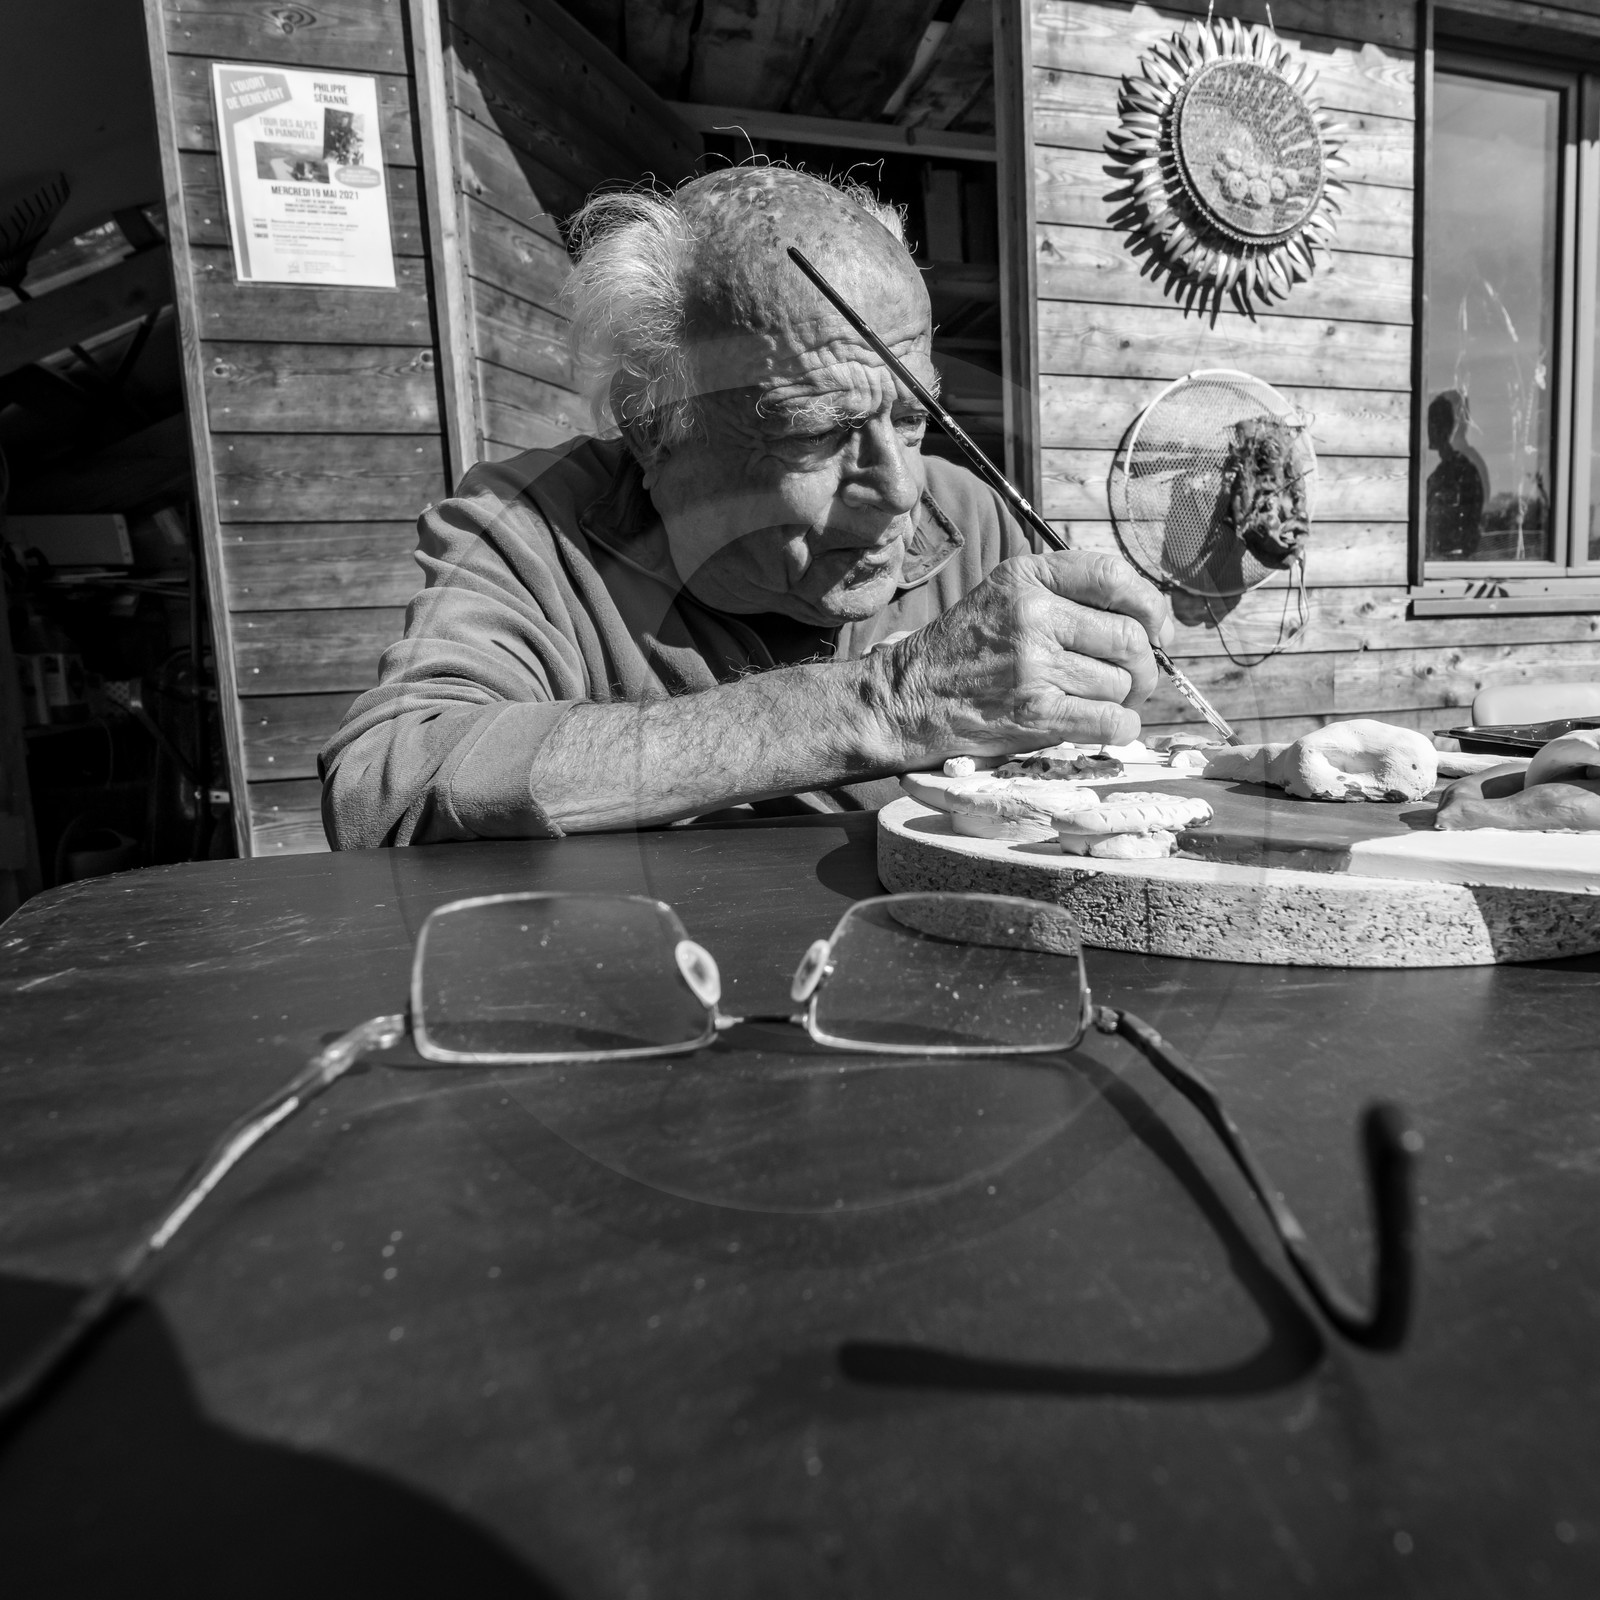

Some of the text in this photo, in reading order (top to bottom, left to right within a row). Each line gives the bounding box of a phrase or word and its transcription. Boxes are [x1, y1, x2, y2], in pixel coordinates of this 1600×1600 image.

[313, 82, 347, 94] PHILIPPE
[226, 96, 240, 110] DE
[314, 93, 348, 105] SÉRANNE
[260, 117, 318, 130] TOUR DES ALPES
[264, 127, 315, 139] EN PIANOVÉLO
[271, 185, 359, 200] MERCREDI 19 MAI 2021
